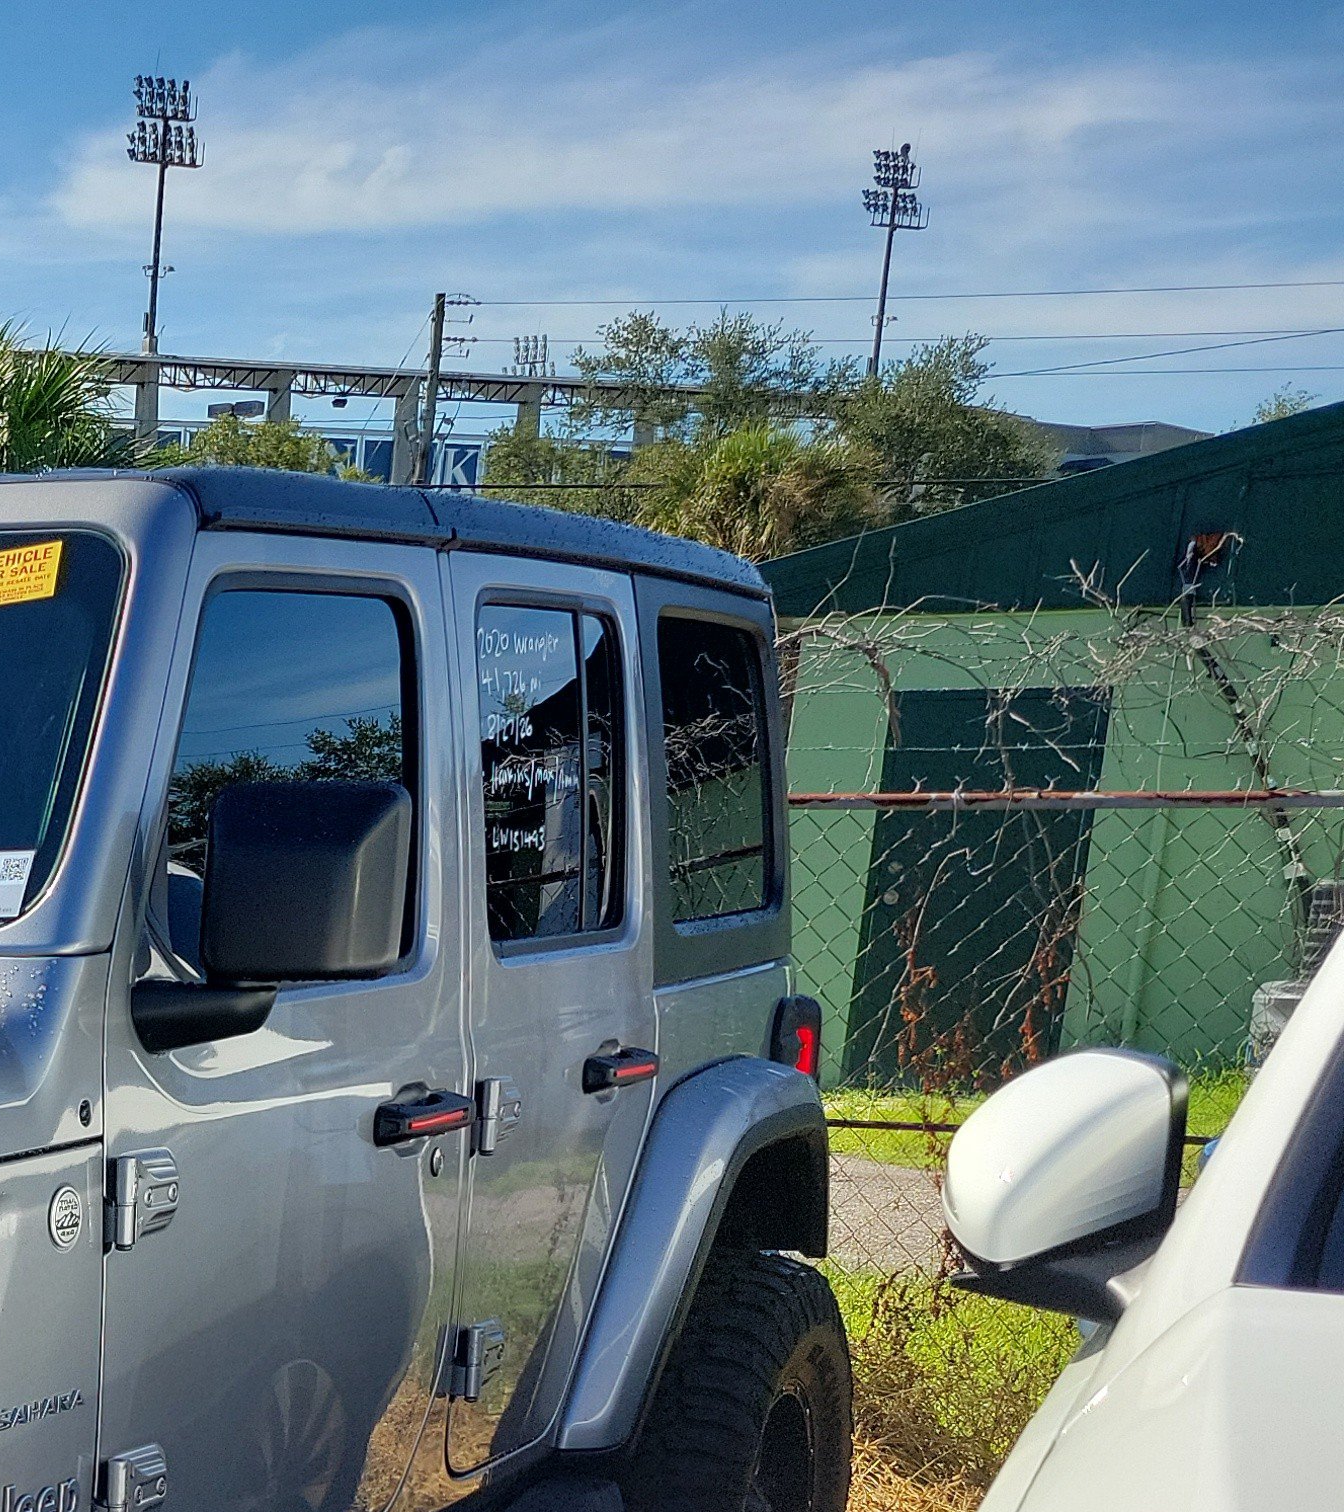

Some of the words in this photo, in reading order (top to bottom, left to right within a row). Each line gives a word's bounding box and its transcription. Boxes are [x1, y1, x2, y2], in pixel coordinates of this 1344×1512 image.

[10, 562, 47, 577] SALE
[477, 628, 509, 659] 2020
[481, 667, 526, 704] 41,726
[492, 826, 545, 852] LW151493
[59, 1204, 78, 1213] RATED
[60, 1198, 78, 1207] TRAIL
